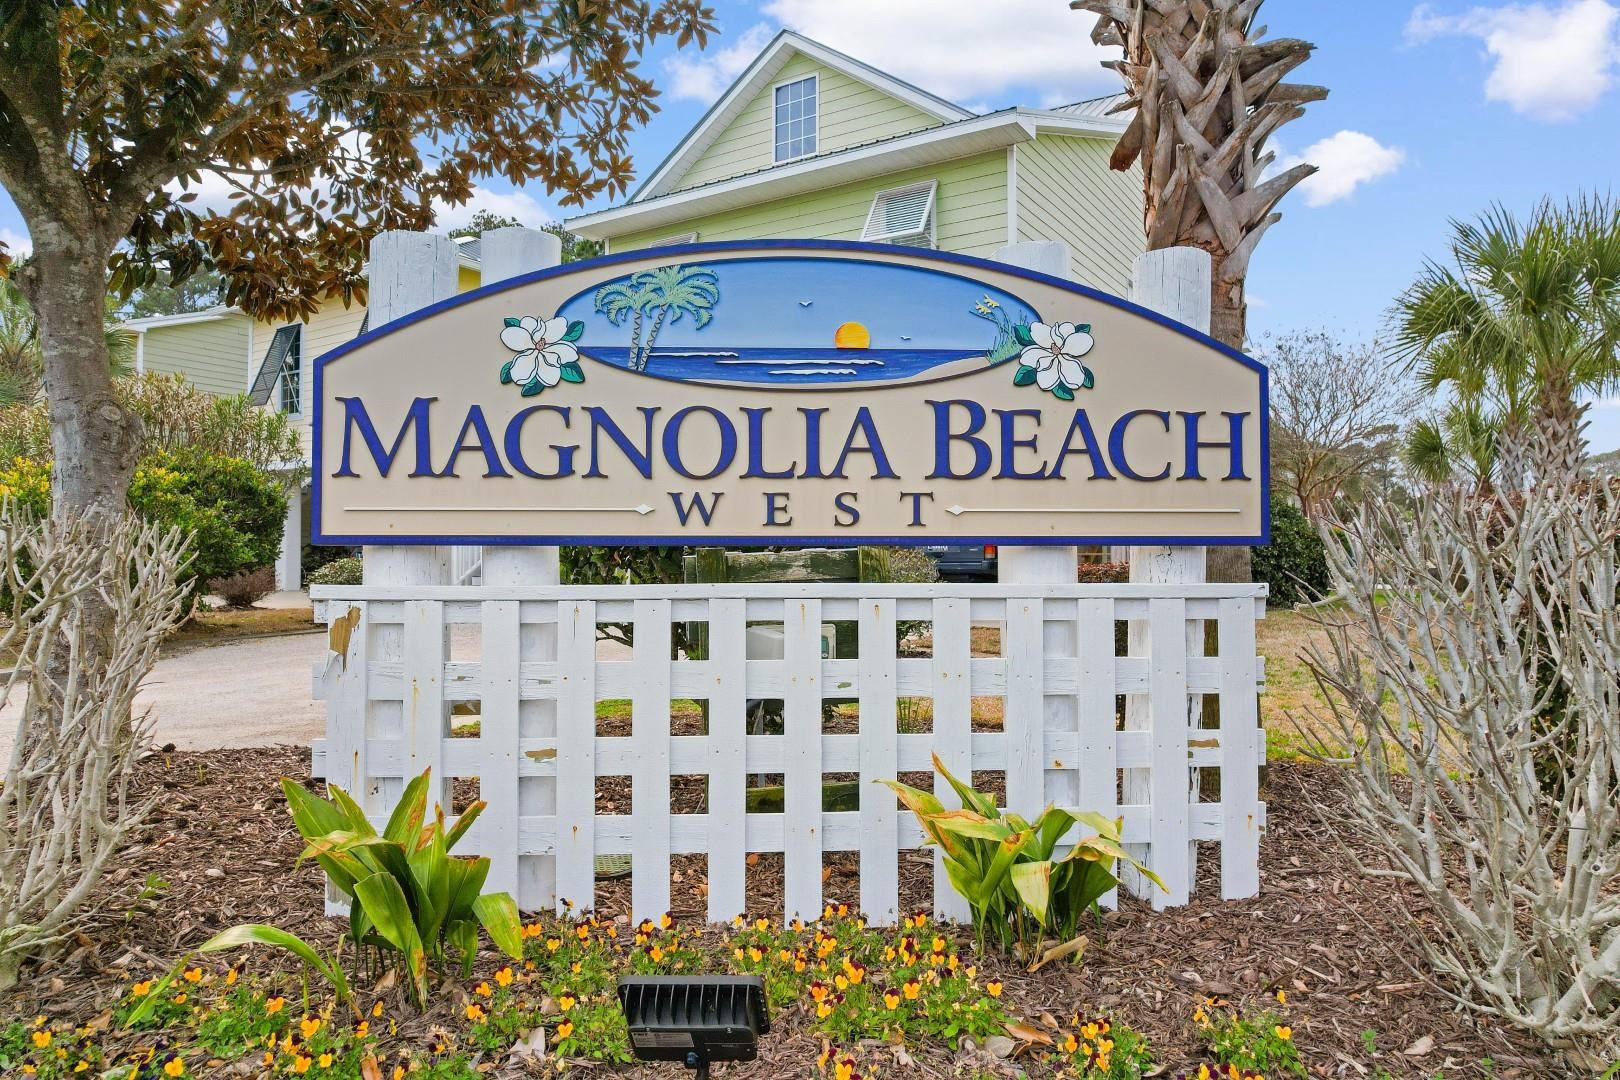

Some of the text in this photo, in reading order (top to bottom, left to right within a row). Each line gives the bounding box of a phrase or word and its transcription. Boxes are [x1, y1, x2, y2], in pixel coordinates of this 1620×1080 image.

[332, 397, 1251, 482] MAGNOLIA BEACH
[667, 492, 934, 527] WEST
